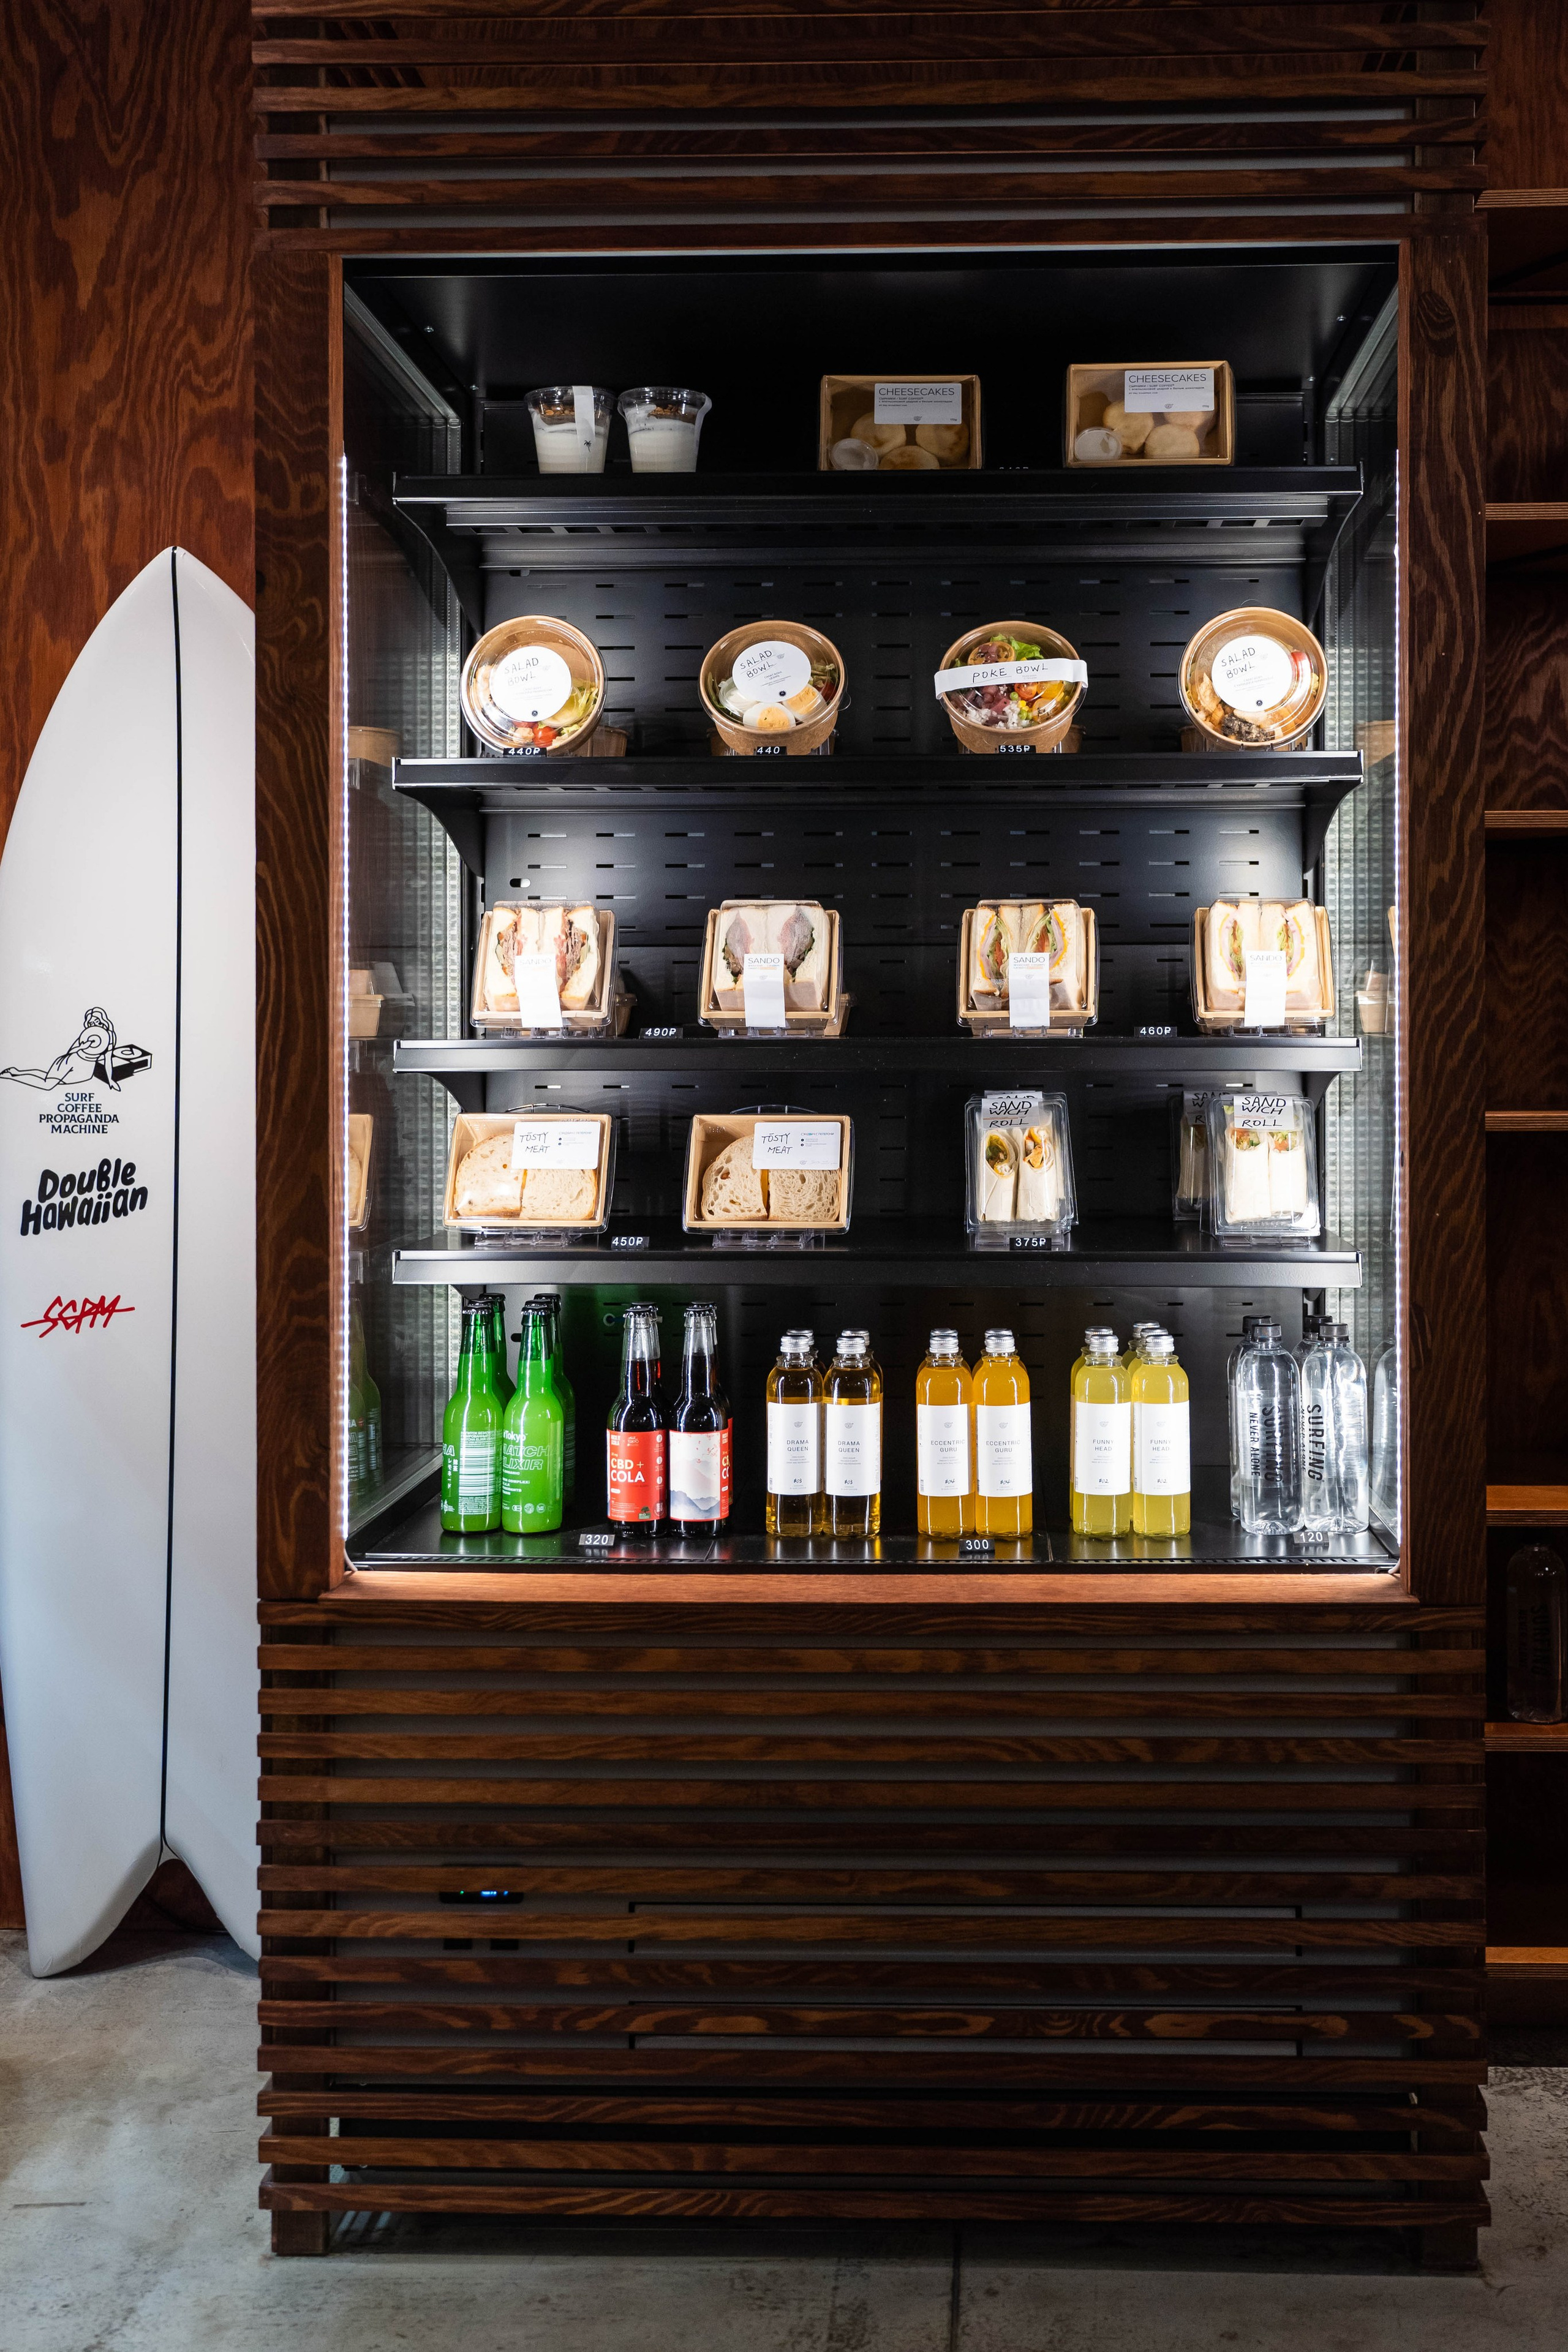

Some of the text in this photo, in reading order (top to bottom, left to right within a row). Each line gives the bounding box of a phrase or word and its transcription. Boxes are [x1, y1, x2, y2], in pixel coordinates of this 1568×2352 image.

[1129, 374, 1206, 383] CHEESECAKES
[740, 650, 773, 669] SALAD
[1221, 647, 1256, 667] SALAD
[504, 657, 539, 674] SALAD
[746, 660, 774, 679] BOWL
[1226, 661, 1256, 679] BOWL
[508, 671, 537, 687] BOWL
[972, 668, 1008, 684] POKE
[1016, 663, 1049, 674] BOWL
[756, 746, 780, 755] 440
[64, 1092, 95, 1102] SURF
[1242, 1096, 1286, 1107] SAND
[57, 1103, 102, 1113] COFFEE
[989, 1100, 1032, 1111] SAND
[1242, 1105, 1284, 1115] WICH
[39, 1114, 119, 1123] PROPAGANDA
[989, 1118, 1029, 1128] ROLL
[1242, 1118, 1283, 1128] ROLL
[51, 1124, 108, 1134] MACHINE
[524, 1145, 551, 1154] MEAT
[767, 1146, 793, 1155] MEAT
[1249, 1412, 1261, 1477] NEVER ALONE
[1306, 1404, 1325, 1482] SURFING
[611, 1458, 634, 1470] CBD
[611, 1469, 645, 1483] COLA
[585, 1534, 609, 1545] 320
[1300, 1531, 1323, 1543] 120
[965, 1539, 989, 1550] 300
